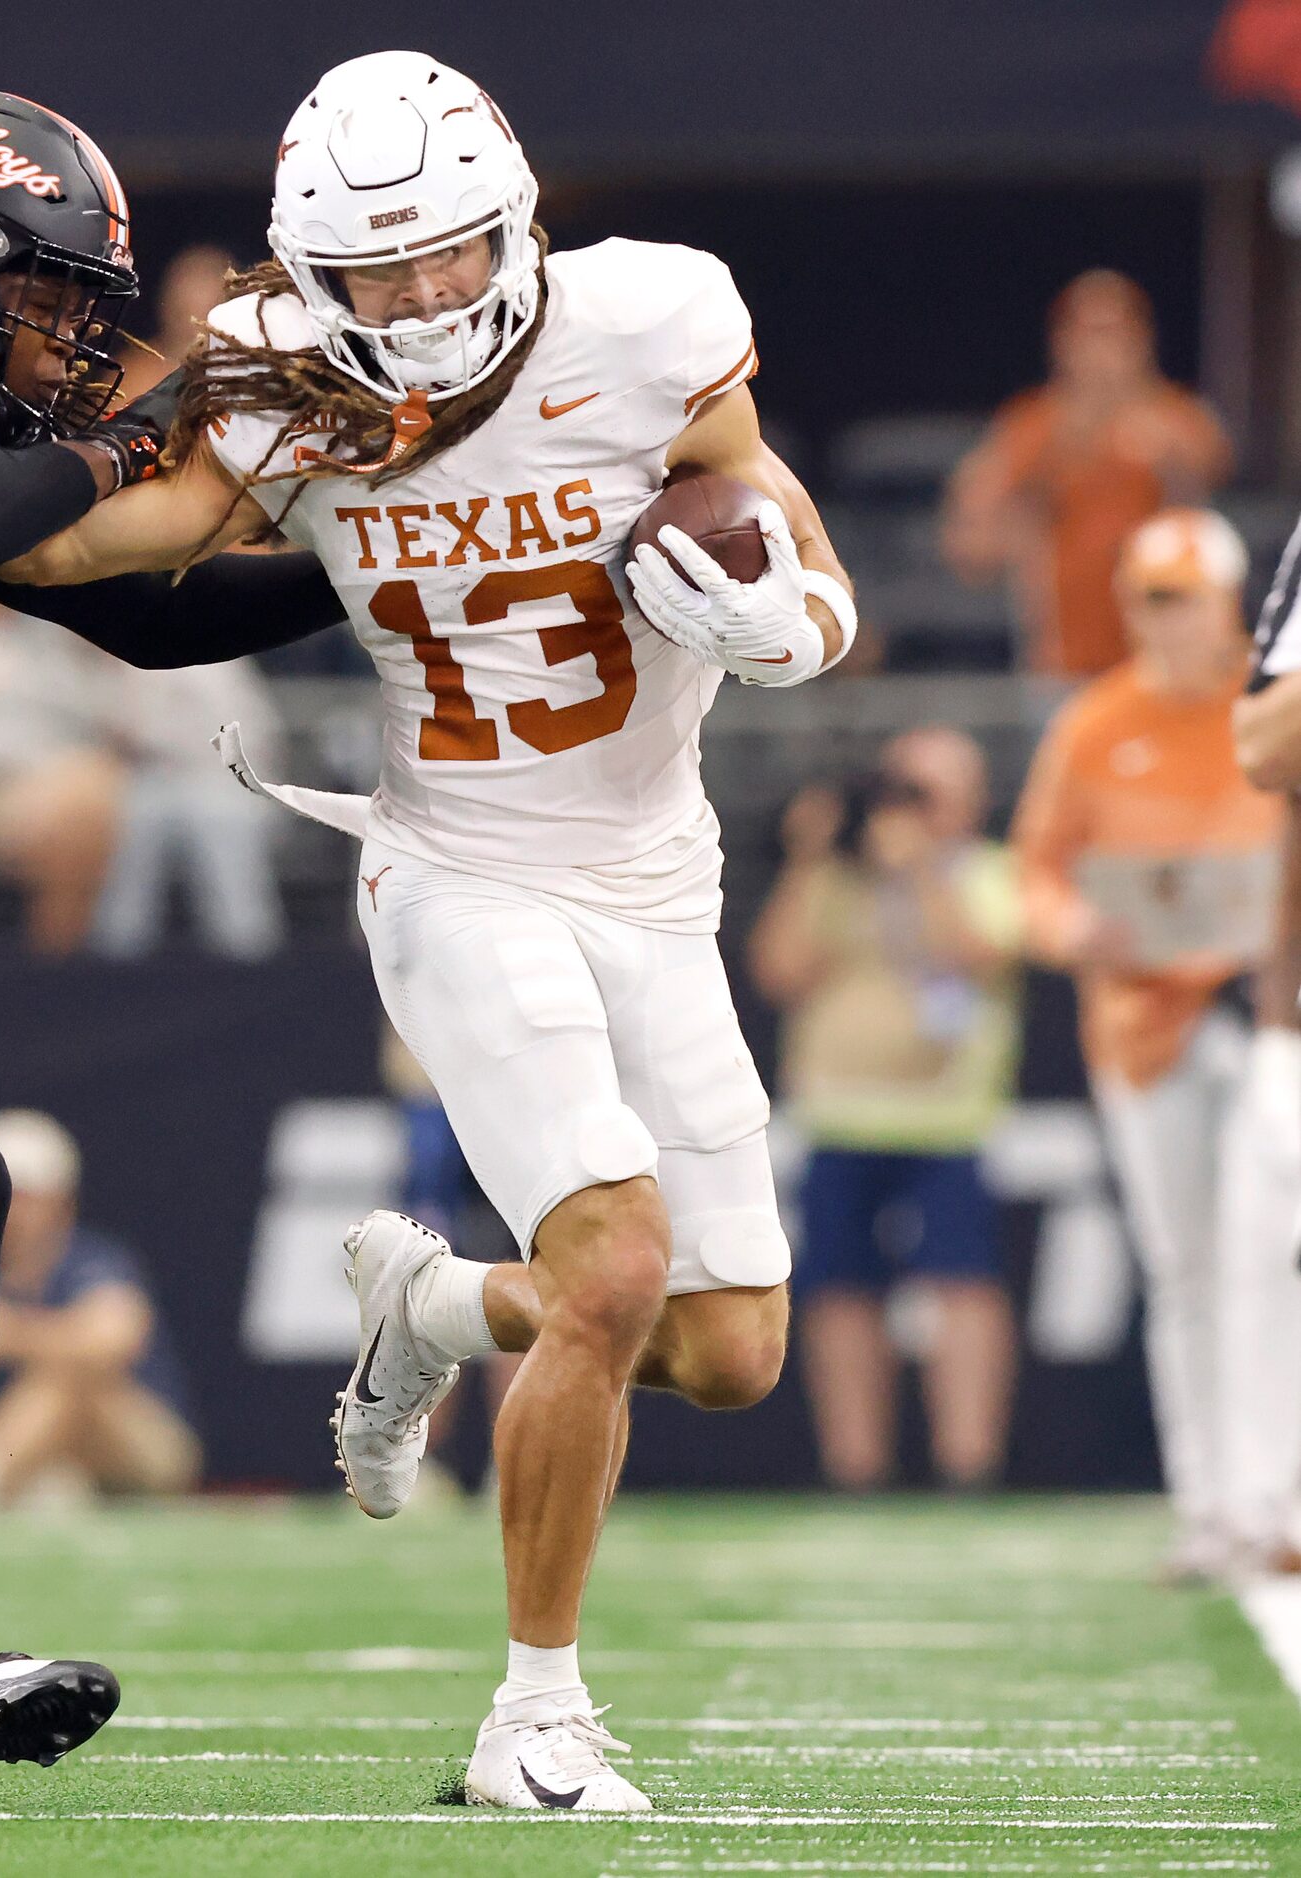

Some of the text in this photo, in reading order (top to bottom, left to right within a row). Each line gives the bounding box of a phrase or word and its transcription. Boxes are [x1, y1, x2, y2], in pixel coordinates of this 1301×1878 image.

[368, 205, 419, 230] HORNS
[334, 478, 602, 569] TEXAS
[367, 559, 638, 761] 13
